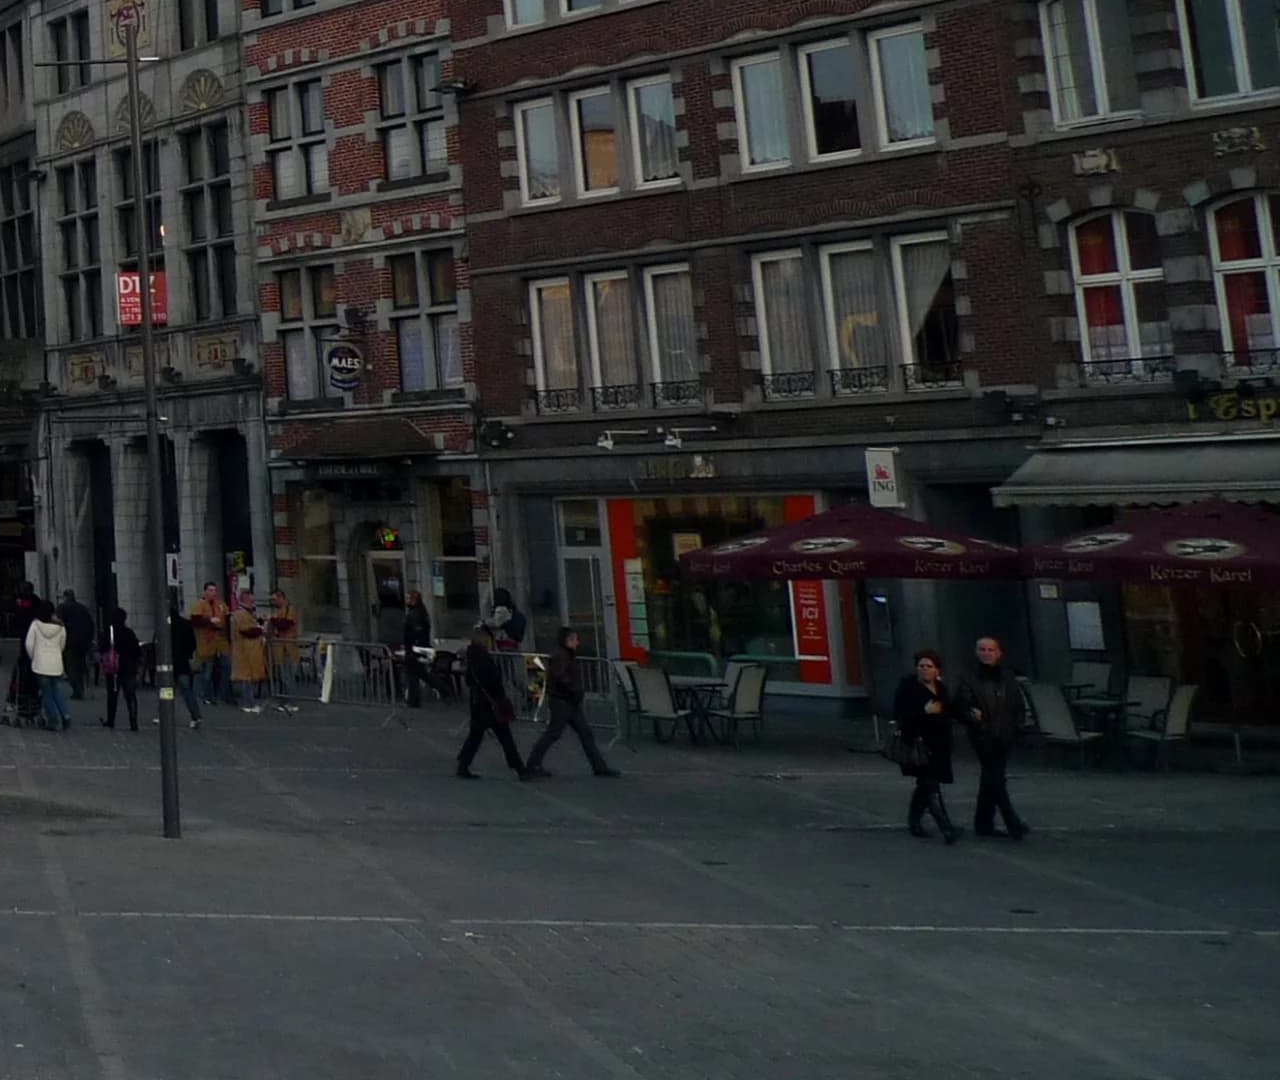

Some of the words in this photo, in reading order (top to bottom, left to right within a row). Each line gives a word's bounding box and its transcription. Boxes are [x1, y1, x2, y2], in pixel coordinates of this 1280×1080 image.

[330, 357, 360, 368] MAES
[1209, 391, 1280, 424] Esp
[872, 481, 896, 492] ING
[772, 559, 822, 575] Charles
[828, 559, 866, 574] Quint
[1150, 564, 1201, 580] Keizer
[1209, 567, 1252, 582] Karel
